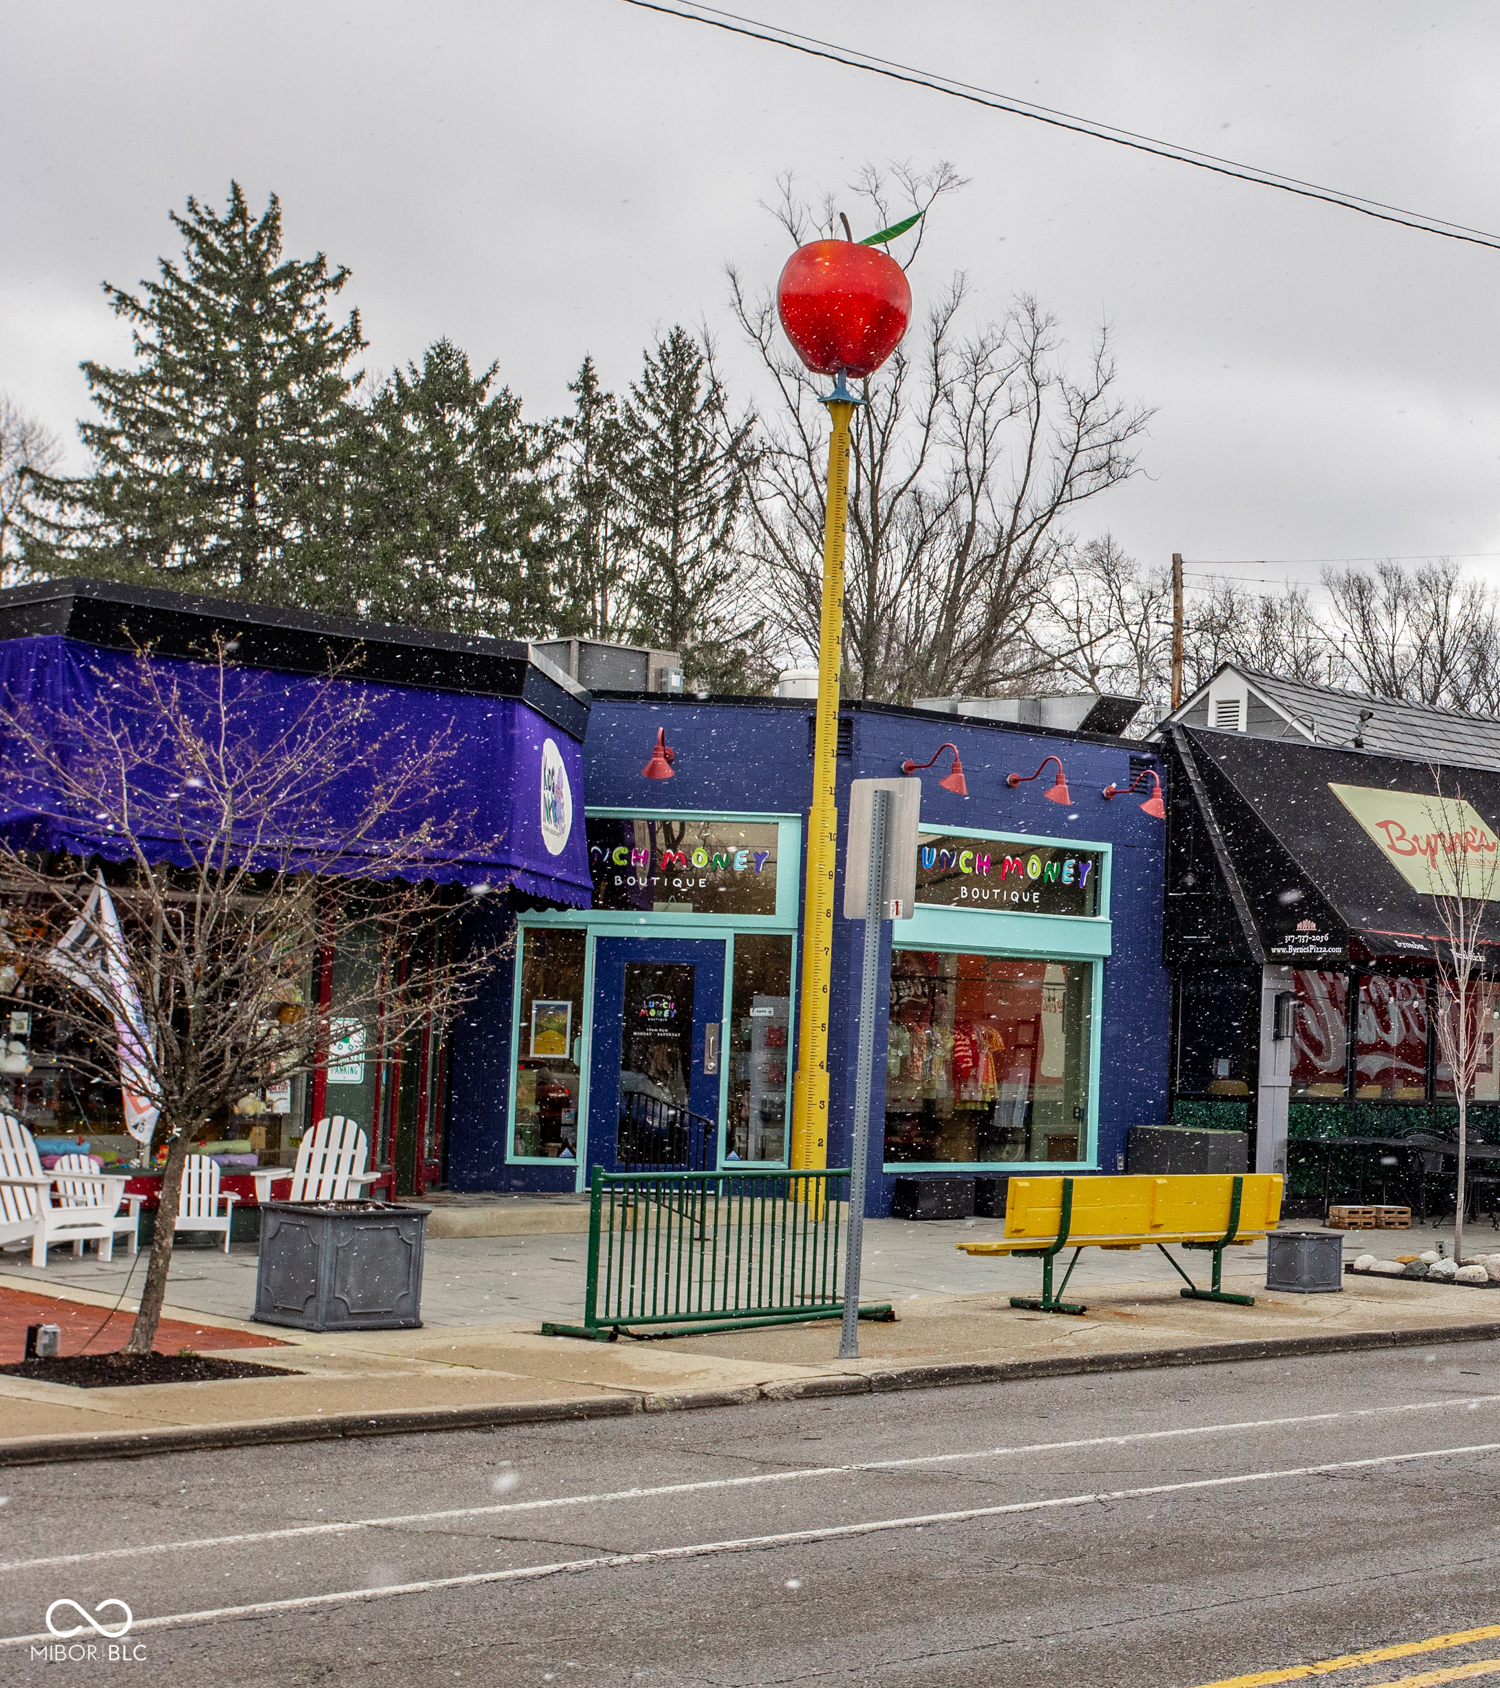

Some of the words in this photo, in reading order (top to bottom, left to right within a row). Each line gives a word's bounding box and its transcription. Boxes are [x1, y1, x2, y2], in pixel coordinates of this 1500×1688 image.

[1375, 819, 1498, 871] Byrne's
[590, 846, 649, 868] NCH
[660, 847, 770, 874] MONEY
[921, 847, 991, 877] UNCH
[1000, 854, 1093, 889] MONEY
[828, 870, 834, 880] 9
[614, 876, 708, 889] BOUTIQUE
[960, 886, 1041, 904] BOUTIQUE
[825, 908, 832, 918] 8
[1284, 932, 1330, 944] 317-737-2056
[824, 947, 830, 956] 7
[822, 984, 828, 994] 6
[642, 1000, 676, 1010] LUNCH
[638, 1008, 678, 1019] MONEY
[820, 1022, 827, 1032] 5
[818, 1060, 825, 1070] 4
[819, 1100, 825, 1110] 3
[817, 1137, 824, 1147] 2
